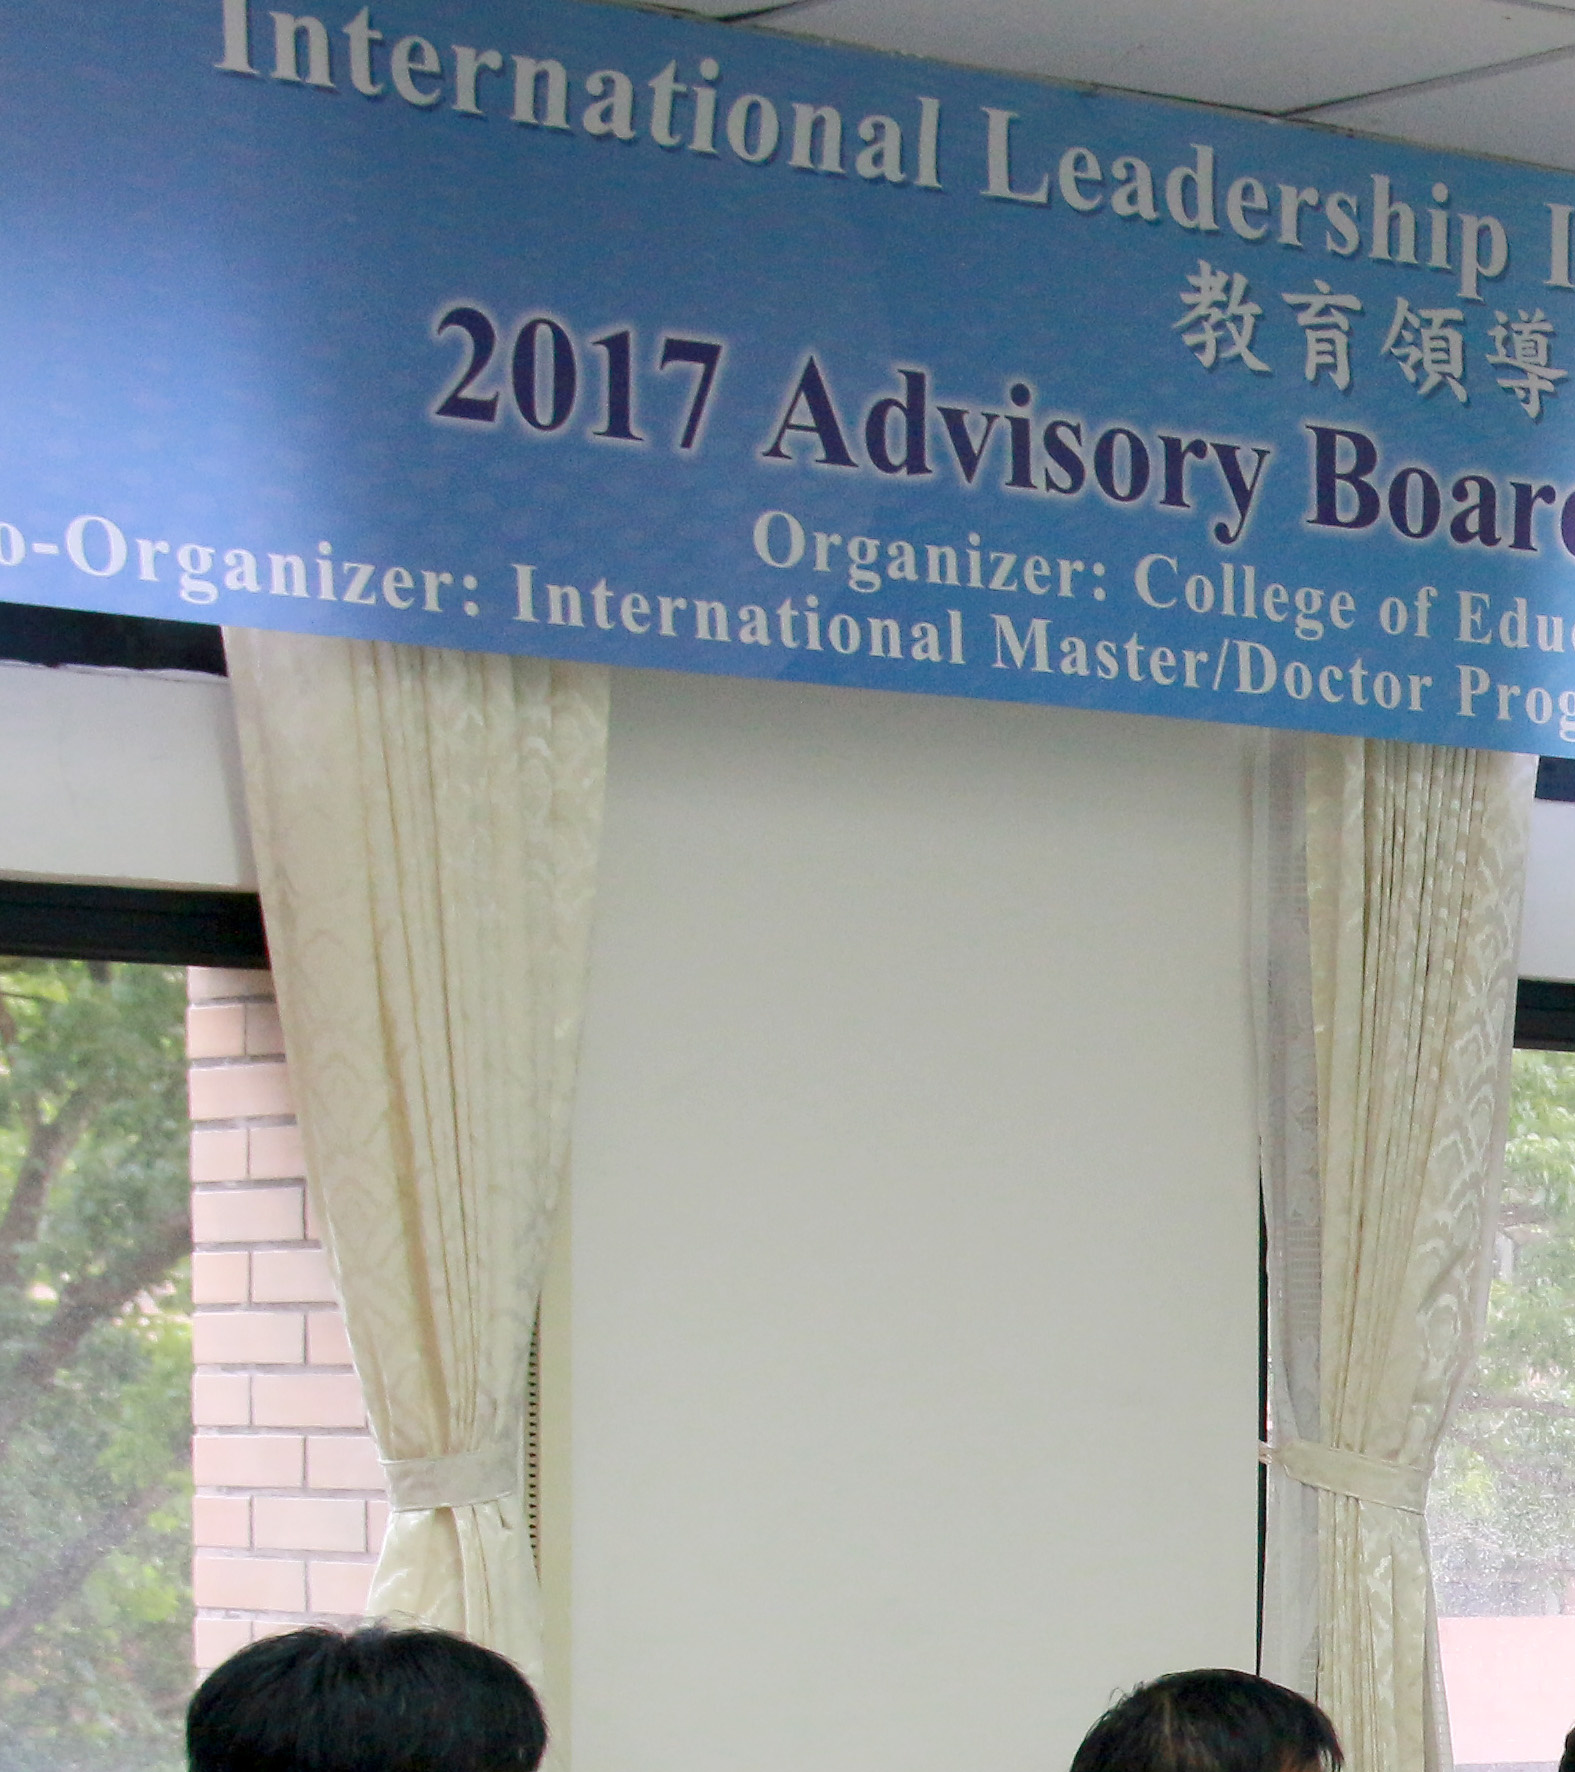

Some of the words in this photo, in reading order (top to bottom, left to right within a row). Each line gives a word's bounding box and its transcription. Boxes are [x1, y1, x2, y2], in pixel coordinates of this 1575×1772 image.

[215, 0, 945, 190] International
[980, 107, 1510, 301] Leadership
[434, 306, 723, 450] 2017
[762, 355, 1271, 545] Advisory
[512, 564, 966, 667] International
[990, 613, 1434, 713] Master/Doctor
[752, 511, 1107, 602] Organizer:
[1134, 553, 1356, 641] College
[1378, 586, 1440, 639] of
